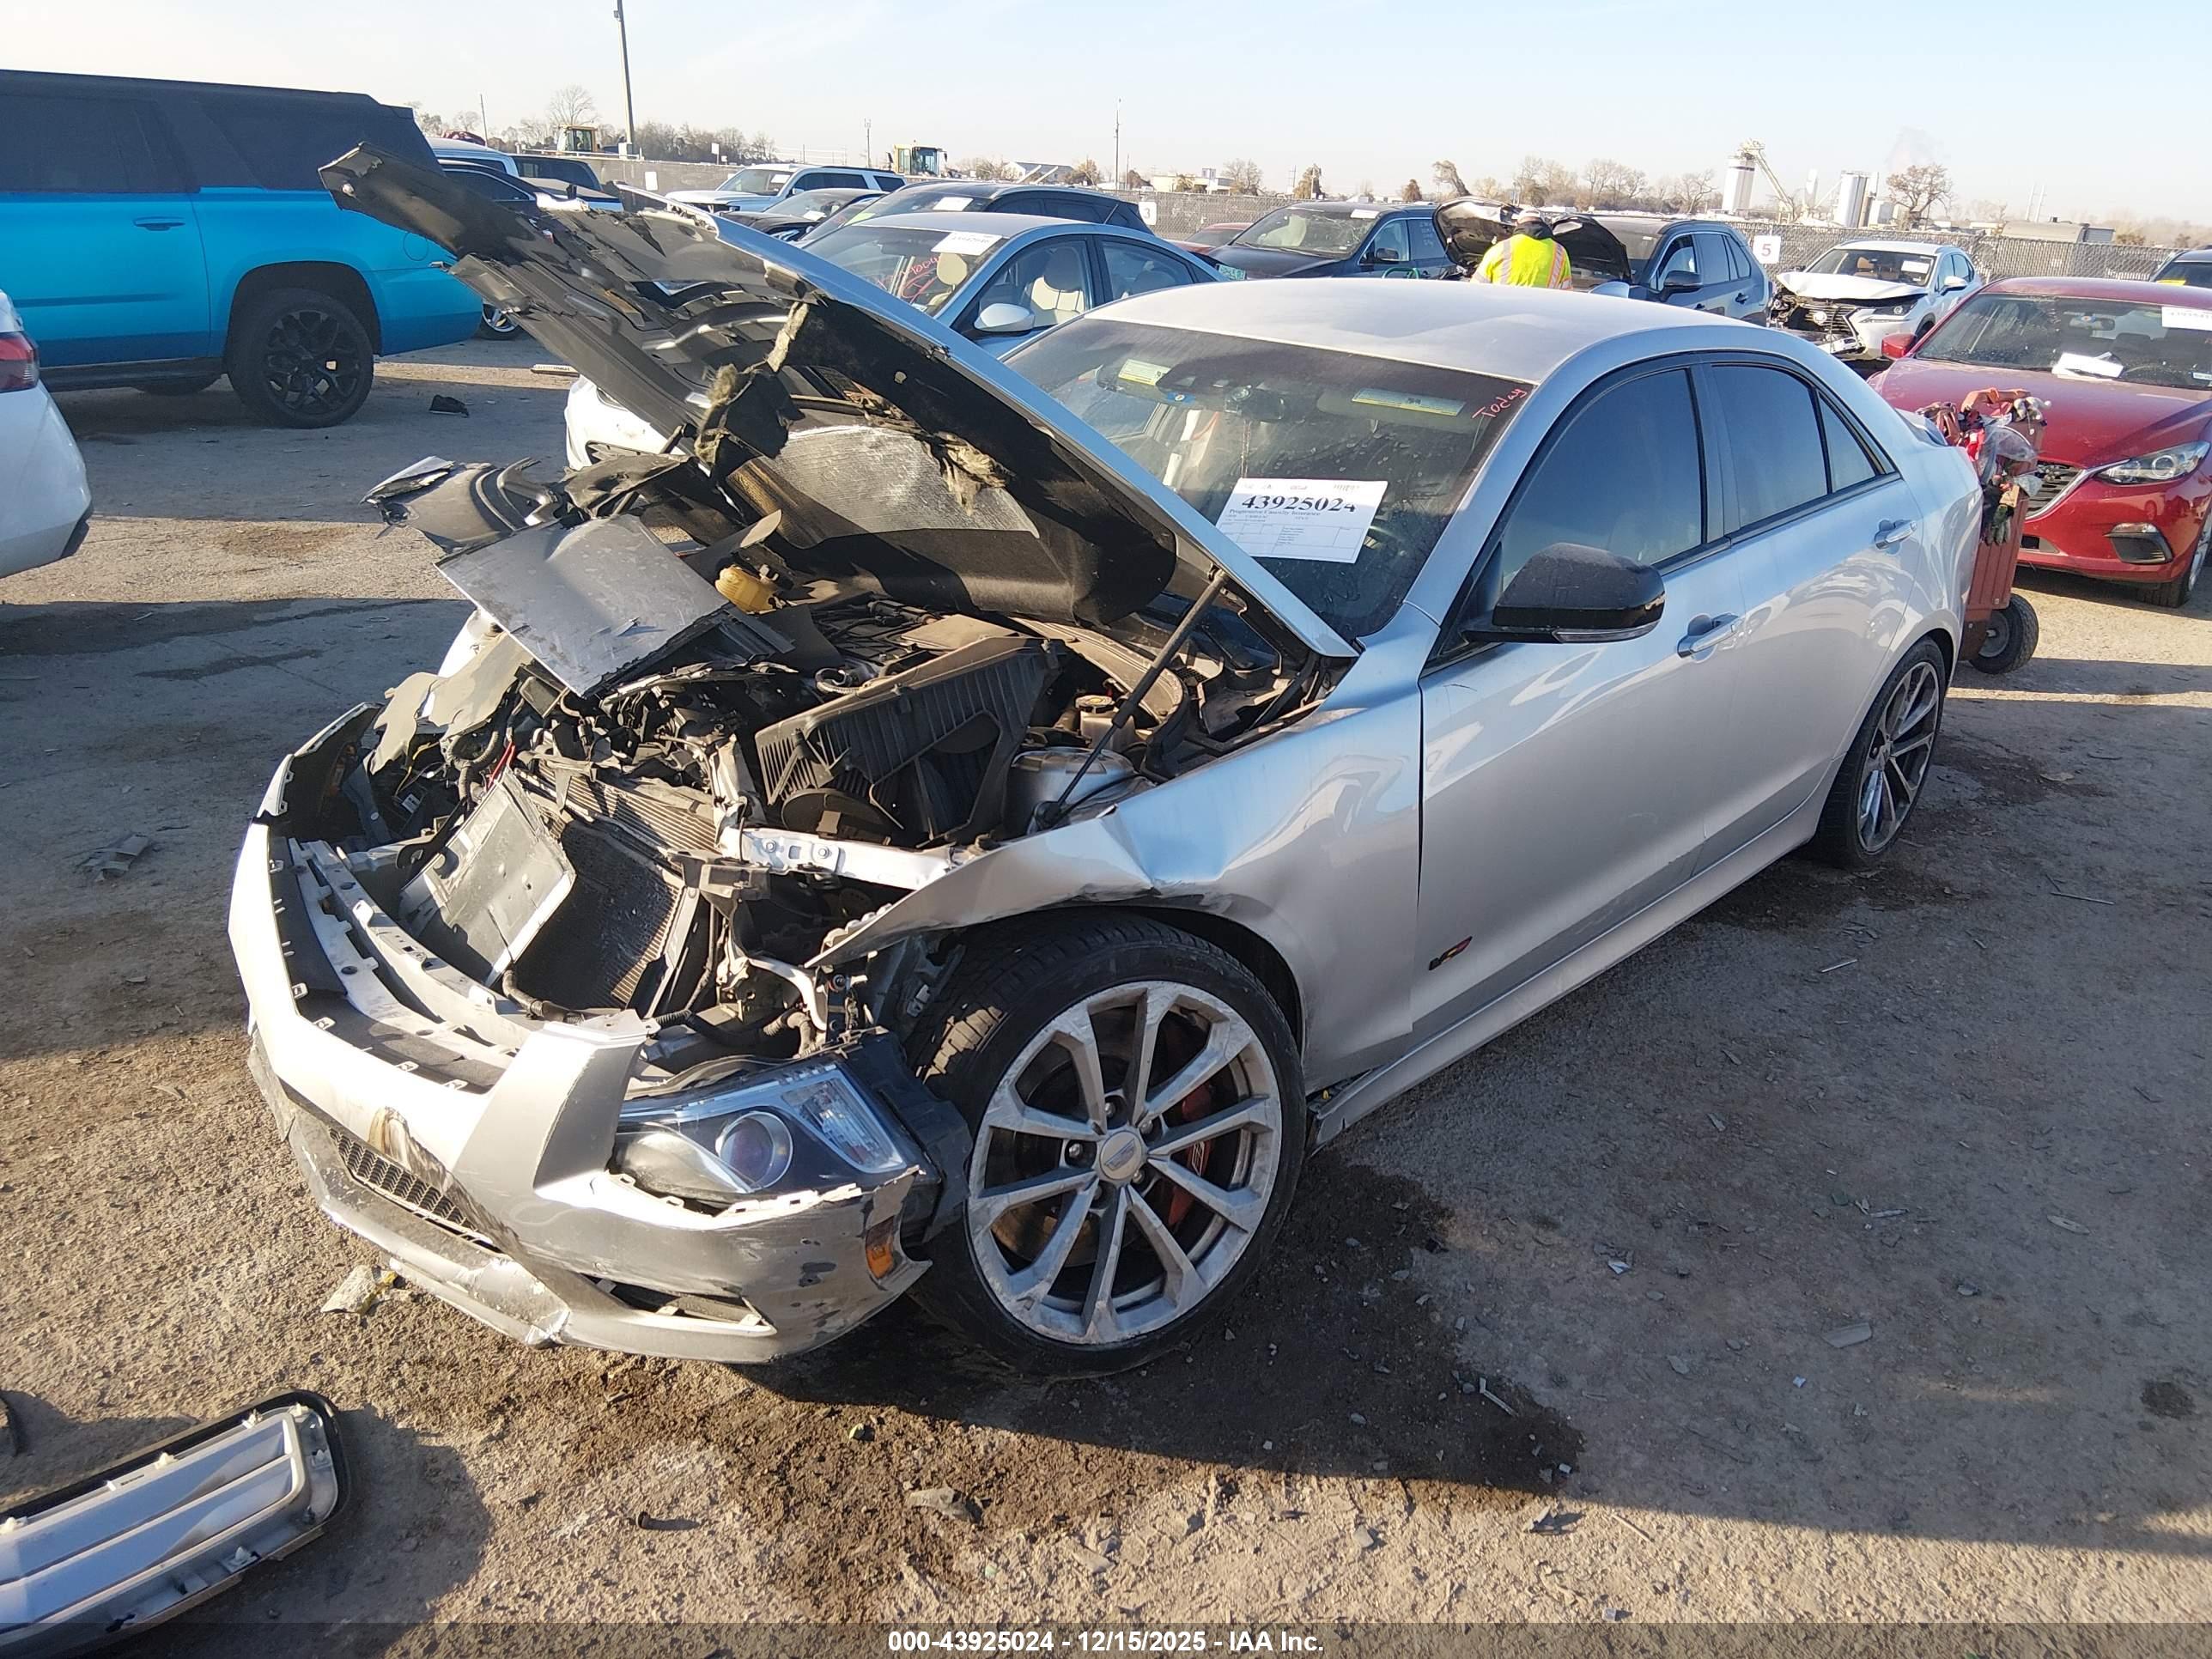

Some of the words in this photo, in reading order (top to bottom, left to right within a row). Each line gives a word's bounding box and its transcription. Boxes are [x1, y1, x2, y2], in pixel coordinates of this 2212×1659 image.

[1760, 243, 1771, 257] 5
[1472, 388, 1528, 419] Today
[1242, 495, 1357, 514] 43925024
